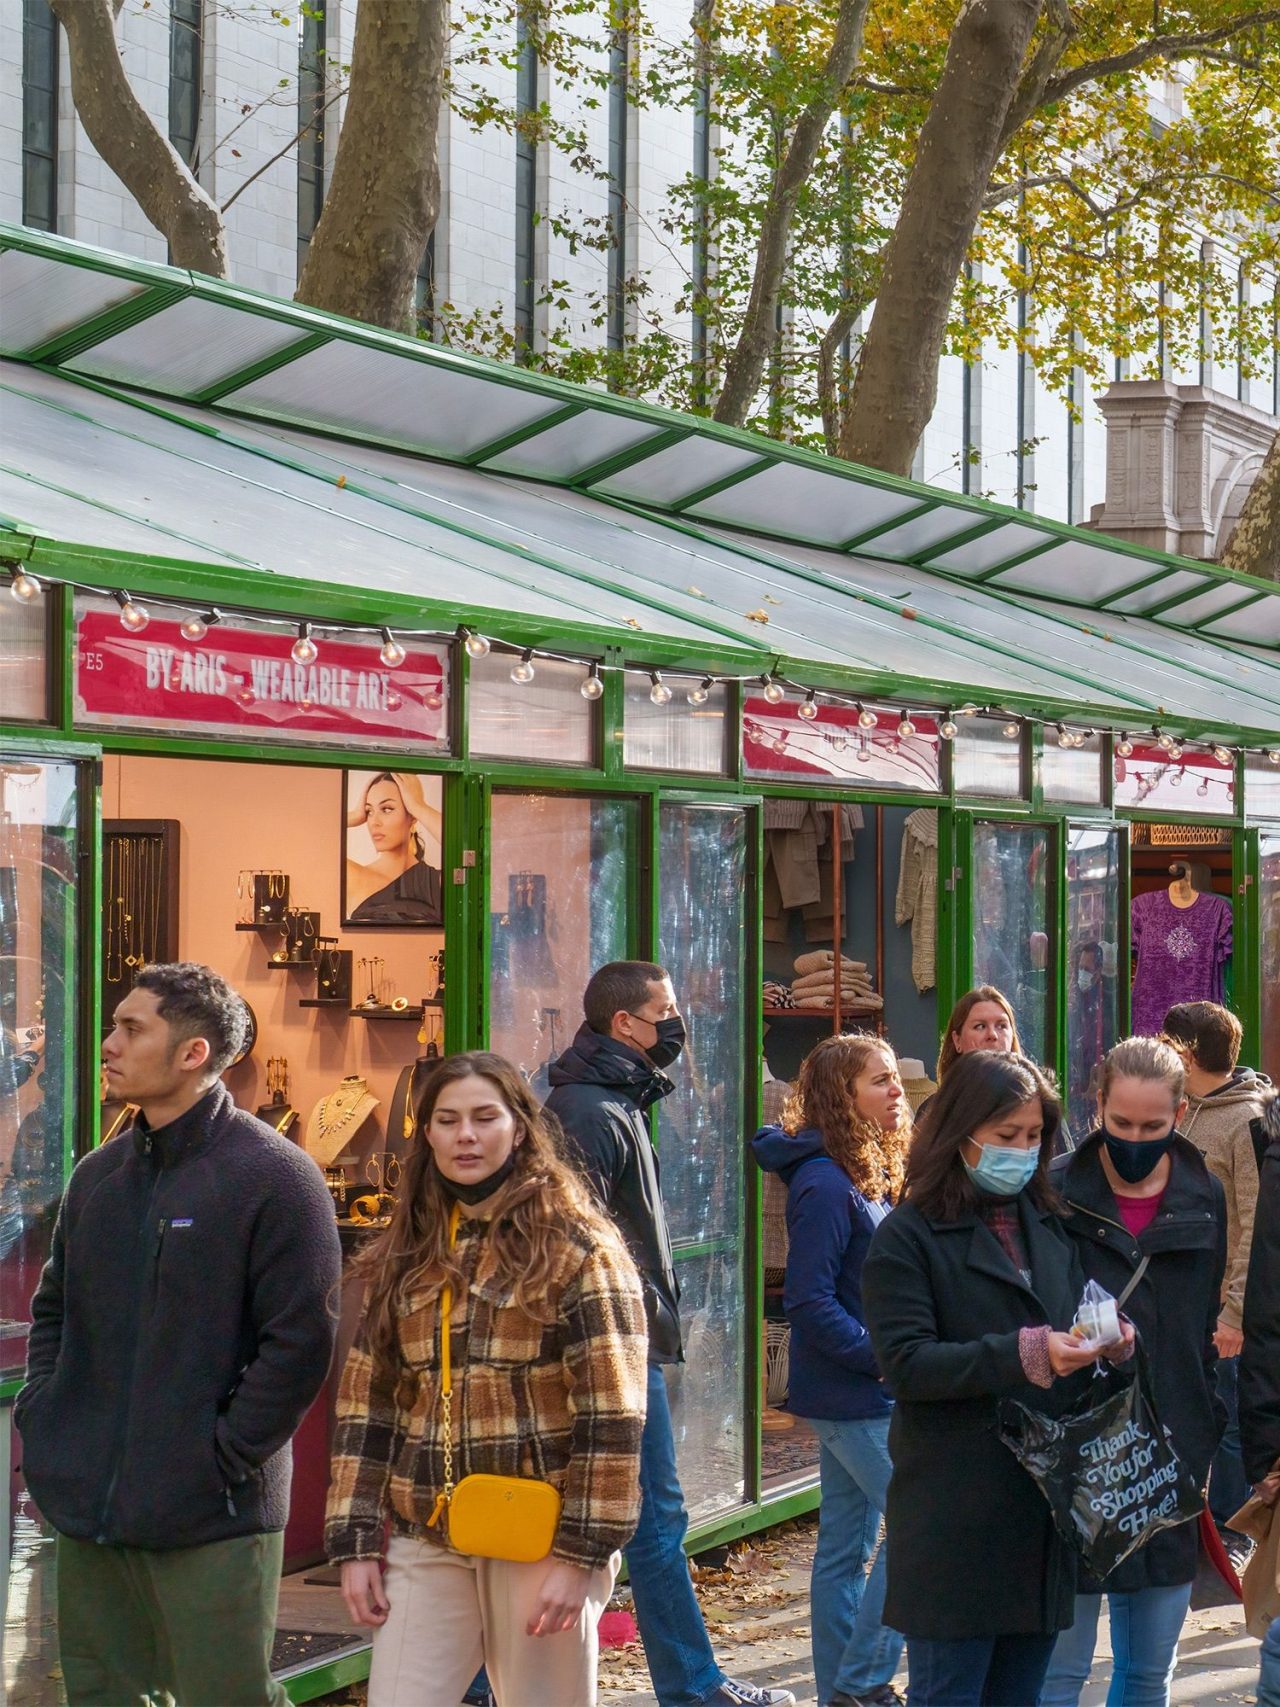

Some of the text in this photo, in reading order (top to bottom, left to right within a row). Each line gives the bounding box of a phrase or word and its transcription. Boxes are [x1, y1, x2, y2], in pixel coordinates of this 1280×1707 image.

[86, 652, 104, 671] E5
[146, 647, 174, 690] BY
[180, 650, 228, 695] ARIS
[251, 658, 351, 708] WEARABLE
[356, 670, 391, 711] ART
[1079, 1420, 1150, 1463] Thank
[1086, 1439, 1158, 1487] You for
[1090, 1459, 1178, 1520] Shopping
